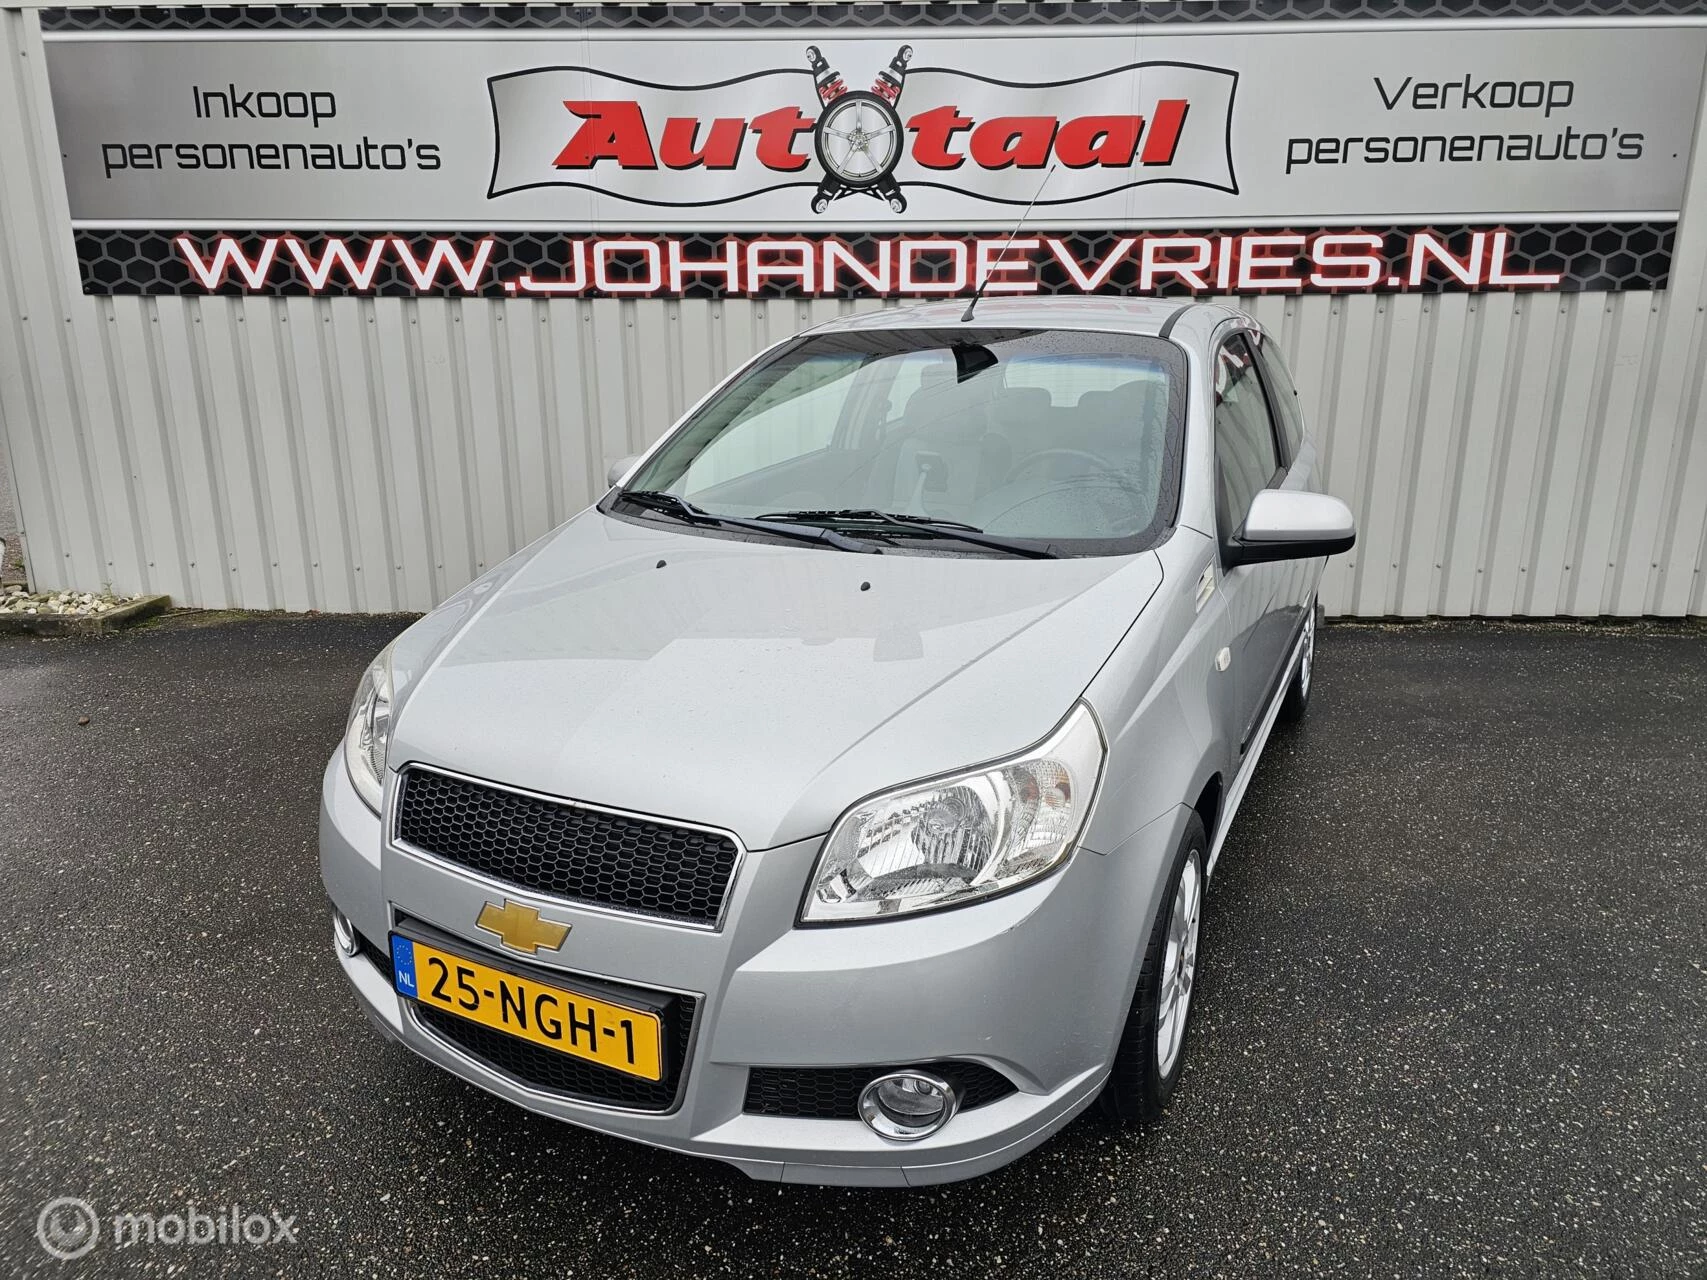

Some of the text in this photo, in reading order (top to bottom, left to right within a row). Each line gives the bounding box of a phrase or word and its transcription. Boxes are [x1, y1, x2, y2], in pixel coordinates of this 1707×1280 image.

[193, 84, 337, 128] Inkoop
[1374, 74, 1575, 117] Verkoop
[103, 137, 442, 179] personenauto's
[1286, 126, 1645, 174] personenauto's
[176, 231, 1561, 293] WWW.JOHANDEVRIES.NL
[398, 970, 415, 988] NL
[428, 957, 635, 1065] 25-NGH-1
